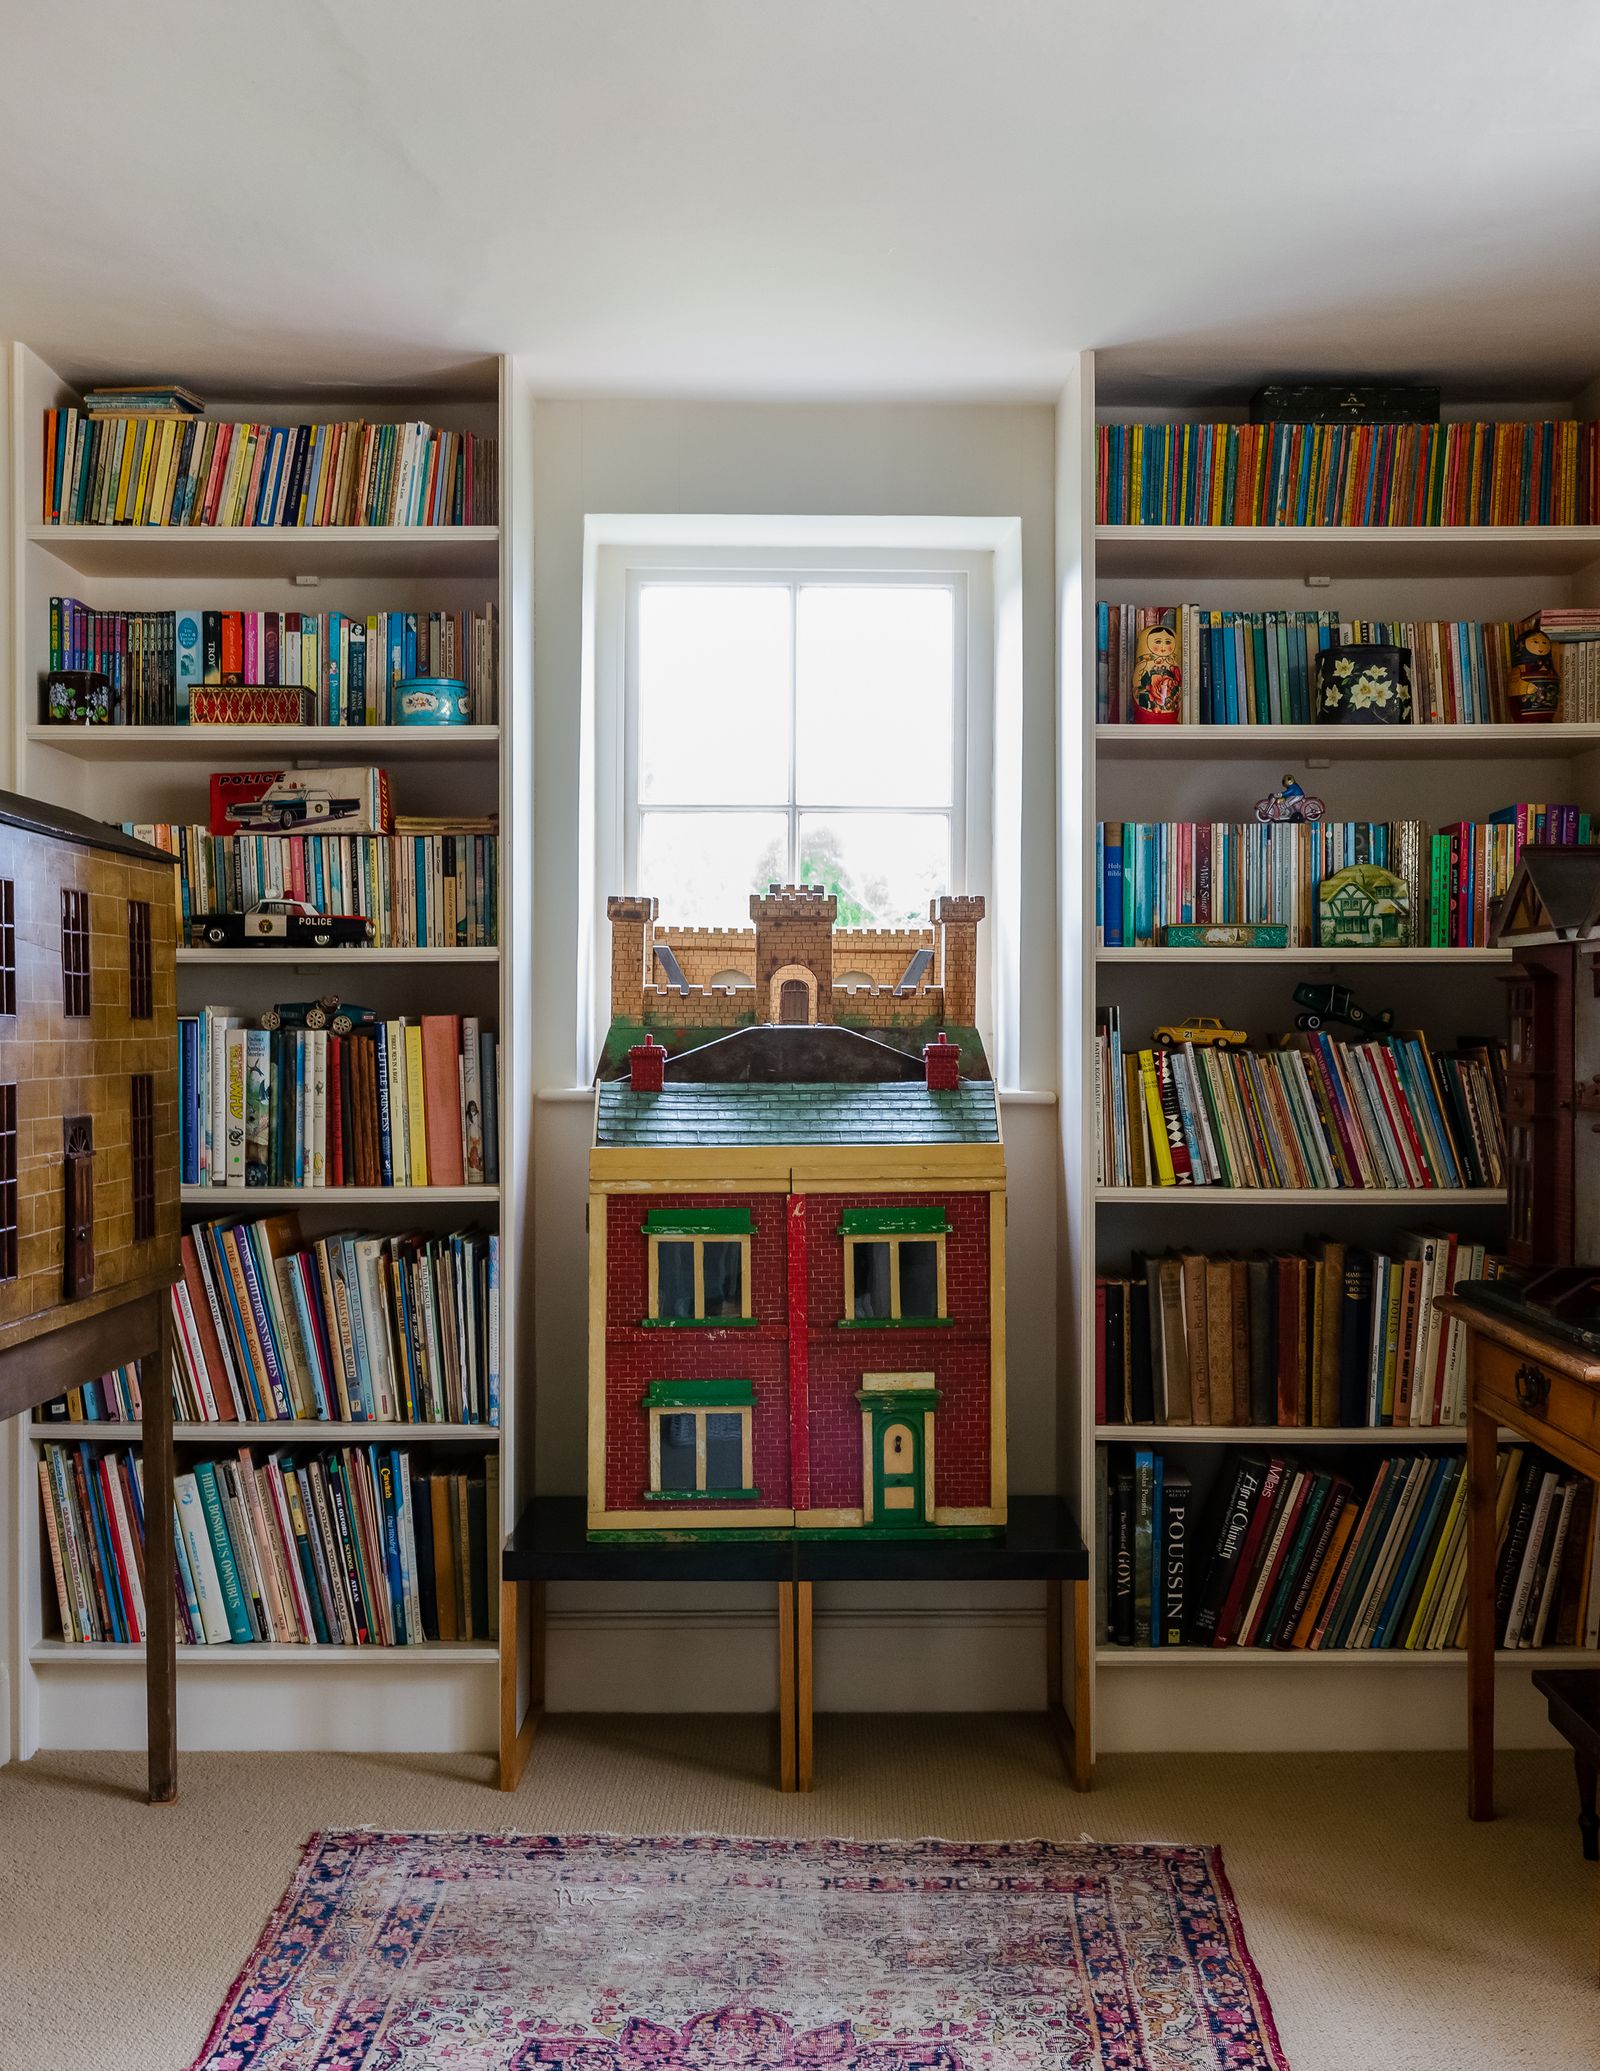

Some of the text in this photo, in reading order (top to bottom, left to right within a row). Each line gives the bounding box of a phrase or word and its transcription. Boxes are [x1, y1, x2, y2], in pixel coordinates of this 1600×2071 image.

[219, 774, 287, 786] POLICE
[378, 776, 391, 831] POLICE
[1199, 865, 1210, 917] Wind Singer
[299, 916, 333, 926] POLICE
[377, 1052, 389, 1086] LITTLE
[463, 1026, 474, 1084] QUEENS
[229, 1081, 244, 1120] WHY
[379, 1088, 390, 1132] PRINCESS
[346, 1248, 358, 1292] TREASURY
[1439, 1244, 1447, 1260] THE
[1409, 1267, 1418, 1288] DOLLS
[1435, 1259, 1447, 1293] WORLD
[206, 1283, 221, 1326] HIAWATHA
[226, 1243, 236, 1264] THE
[231, 1267, 242, 1293] REAL
[237, 1295, 254, 1336] MOTHER
[248, 1339, 262, 1373] GOOSE
[1389, 1298, 1400, 1336] DOLLS
[335, 1279, 356, 1377] ANIMALS OF THE WORLD
[1404, 1306, 1414, 1350] DOLLMAKERS
[264, 1335, 279, 1378] STORIES
[1401, 1358, 1411, 1378] MARY
[205, 1391, 214, 1410] TIGER
[1400, 1378, 1408, 1404] HILLIER
[1140, 1461, 1149, 1516] Nicolas Poussin
[1261, 1464, 1283, 1499] Millais
[1335, 1493, 1346, 1507] THE
[1120, 1511, 1128, 1524] The
[1120, 1524, 1128, 1542] World
[1219, 1474, 1259, 1560] Age of Chivalry
[39, 1469, 68, 1609] THE PIED PIPER OF HAMELIN
[201, 1472, 241, 1609] HILDA BOSWELL'S OMNIBUS
[313, 1472, 347, 1621] YOUNG ANIMALS YOUNG ANIMALS
[335, 1493, 360, 1602] THE OXFORD SCHOOL ATLAS
[1256, 1511, 1289, 1594] THOMAS HART BENTON
[1496, 1502, 1531, 1611] MICHELANGELO
[1116, 1550, 1131, 1598] GOYA
[1166, 1506, 1185, 1619] POUSSIN
[1310, 1558, 1322, 1571] AND
[1293, 1590, 1309, 1612] WORLD
